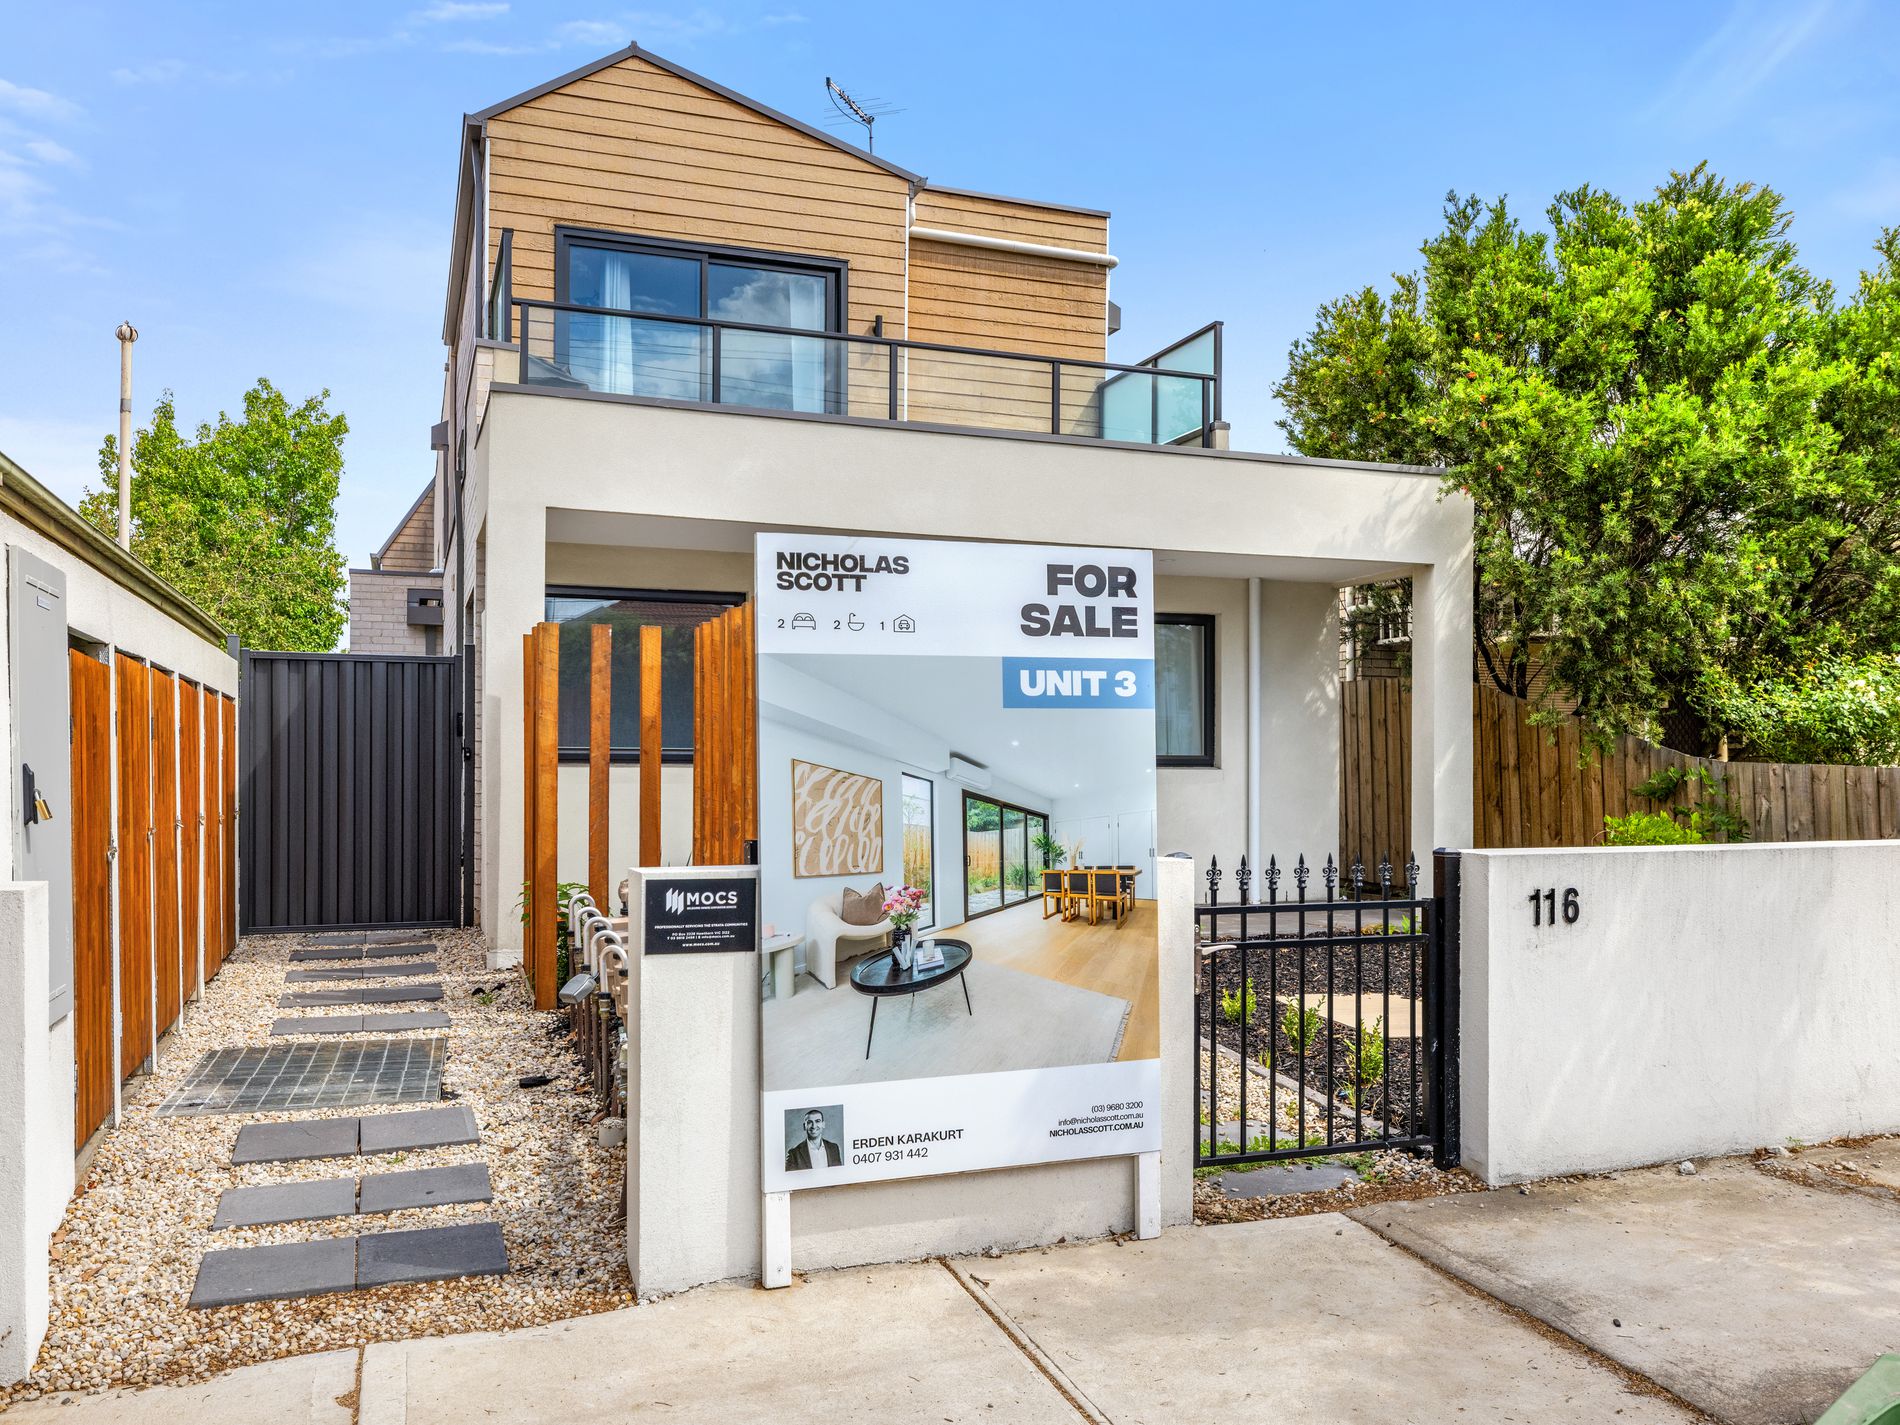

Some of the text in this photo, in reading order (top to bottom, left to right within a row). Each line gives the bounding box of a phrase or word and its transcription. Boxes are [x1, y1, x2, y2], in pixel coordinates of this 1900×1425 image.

[776, 551, 910, 575] NICHOLAS
[776, 572, 868, 592] SCOTT
[1046, 563, 1139, 599] FOR
[777, 618, 885, 631] 2 2 1
[1019, 603, 1139, 639] SALE
[1019, 669, 1138, 697] UNIT 3
[686, 891, 738, 906] MOCS
[1528, 887, 1580, 926] 116
[1091, 1101, 1144, 1114] (03) 9680 3200
[1058, 1112, 1144, 1126] info@nicholasscott.com.au
[852, 1128, 965, 1150] ERDEN KARAKURT
[1049, 1121, 1144, 1138] NICHOLASSCOTT.COM.AU
[852, 1147, 928, 1165] 0407 931 442
